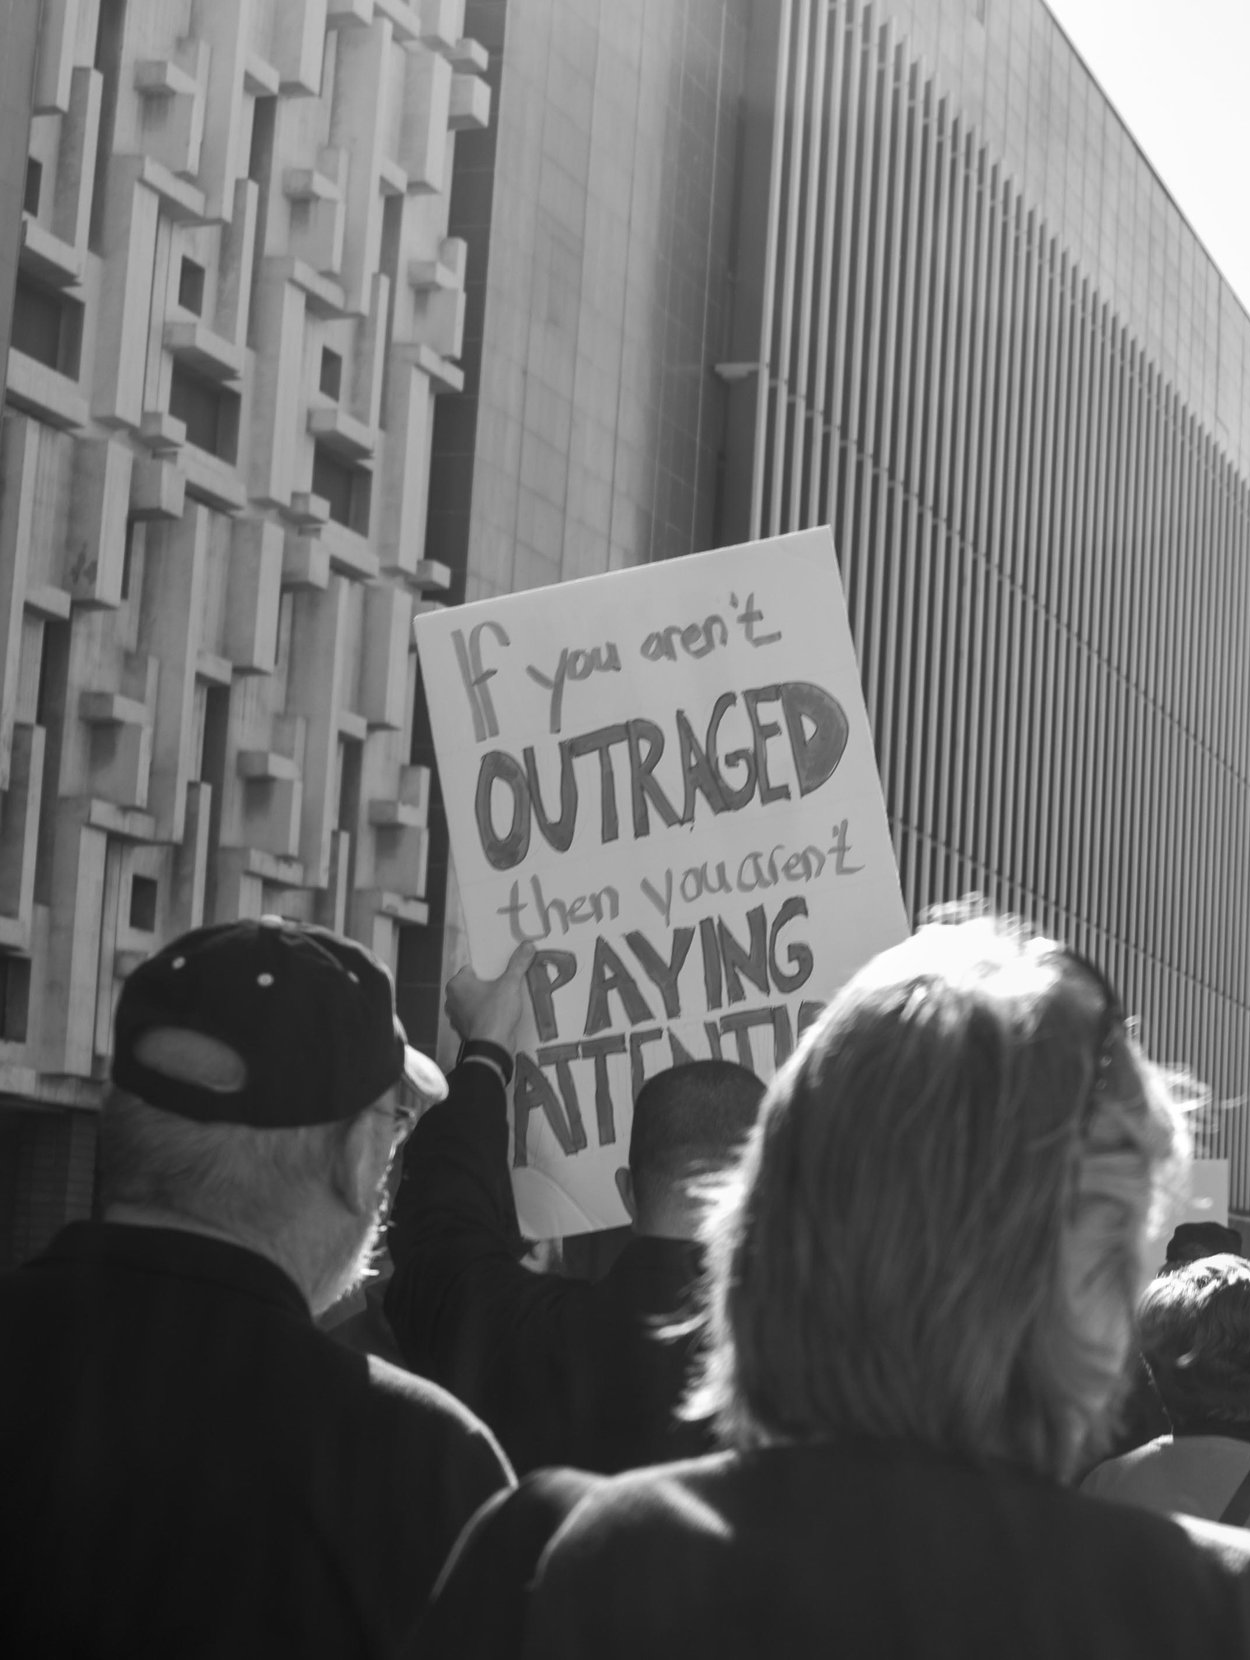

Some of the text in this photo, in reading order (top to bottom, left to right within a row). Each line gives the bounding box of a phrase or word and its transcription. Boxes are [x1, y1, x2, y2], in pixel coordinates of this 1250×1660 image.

[451, 592, 782, 742] If you aren't
[475, 680, 849, 870] OUTRAGED
[497, 875, 619, 942] then
[526, 896, 815, 1042] PAYING
